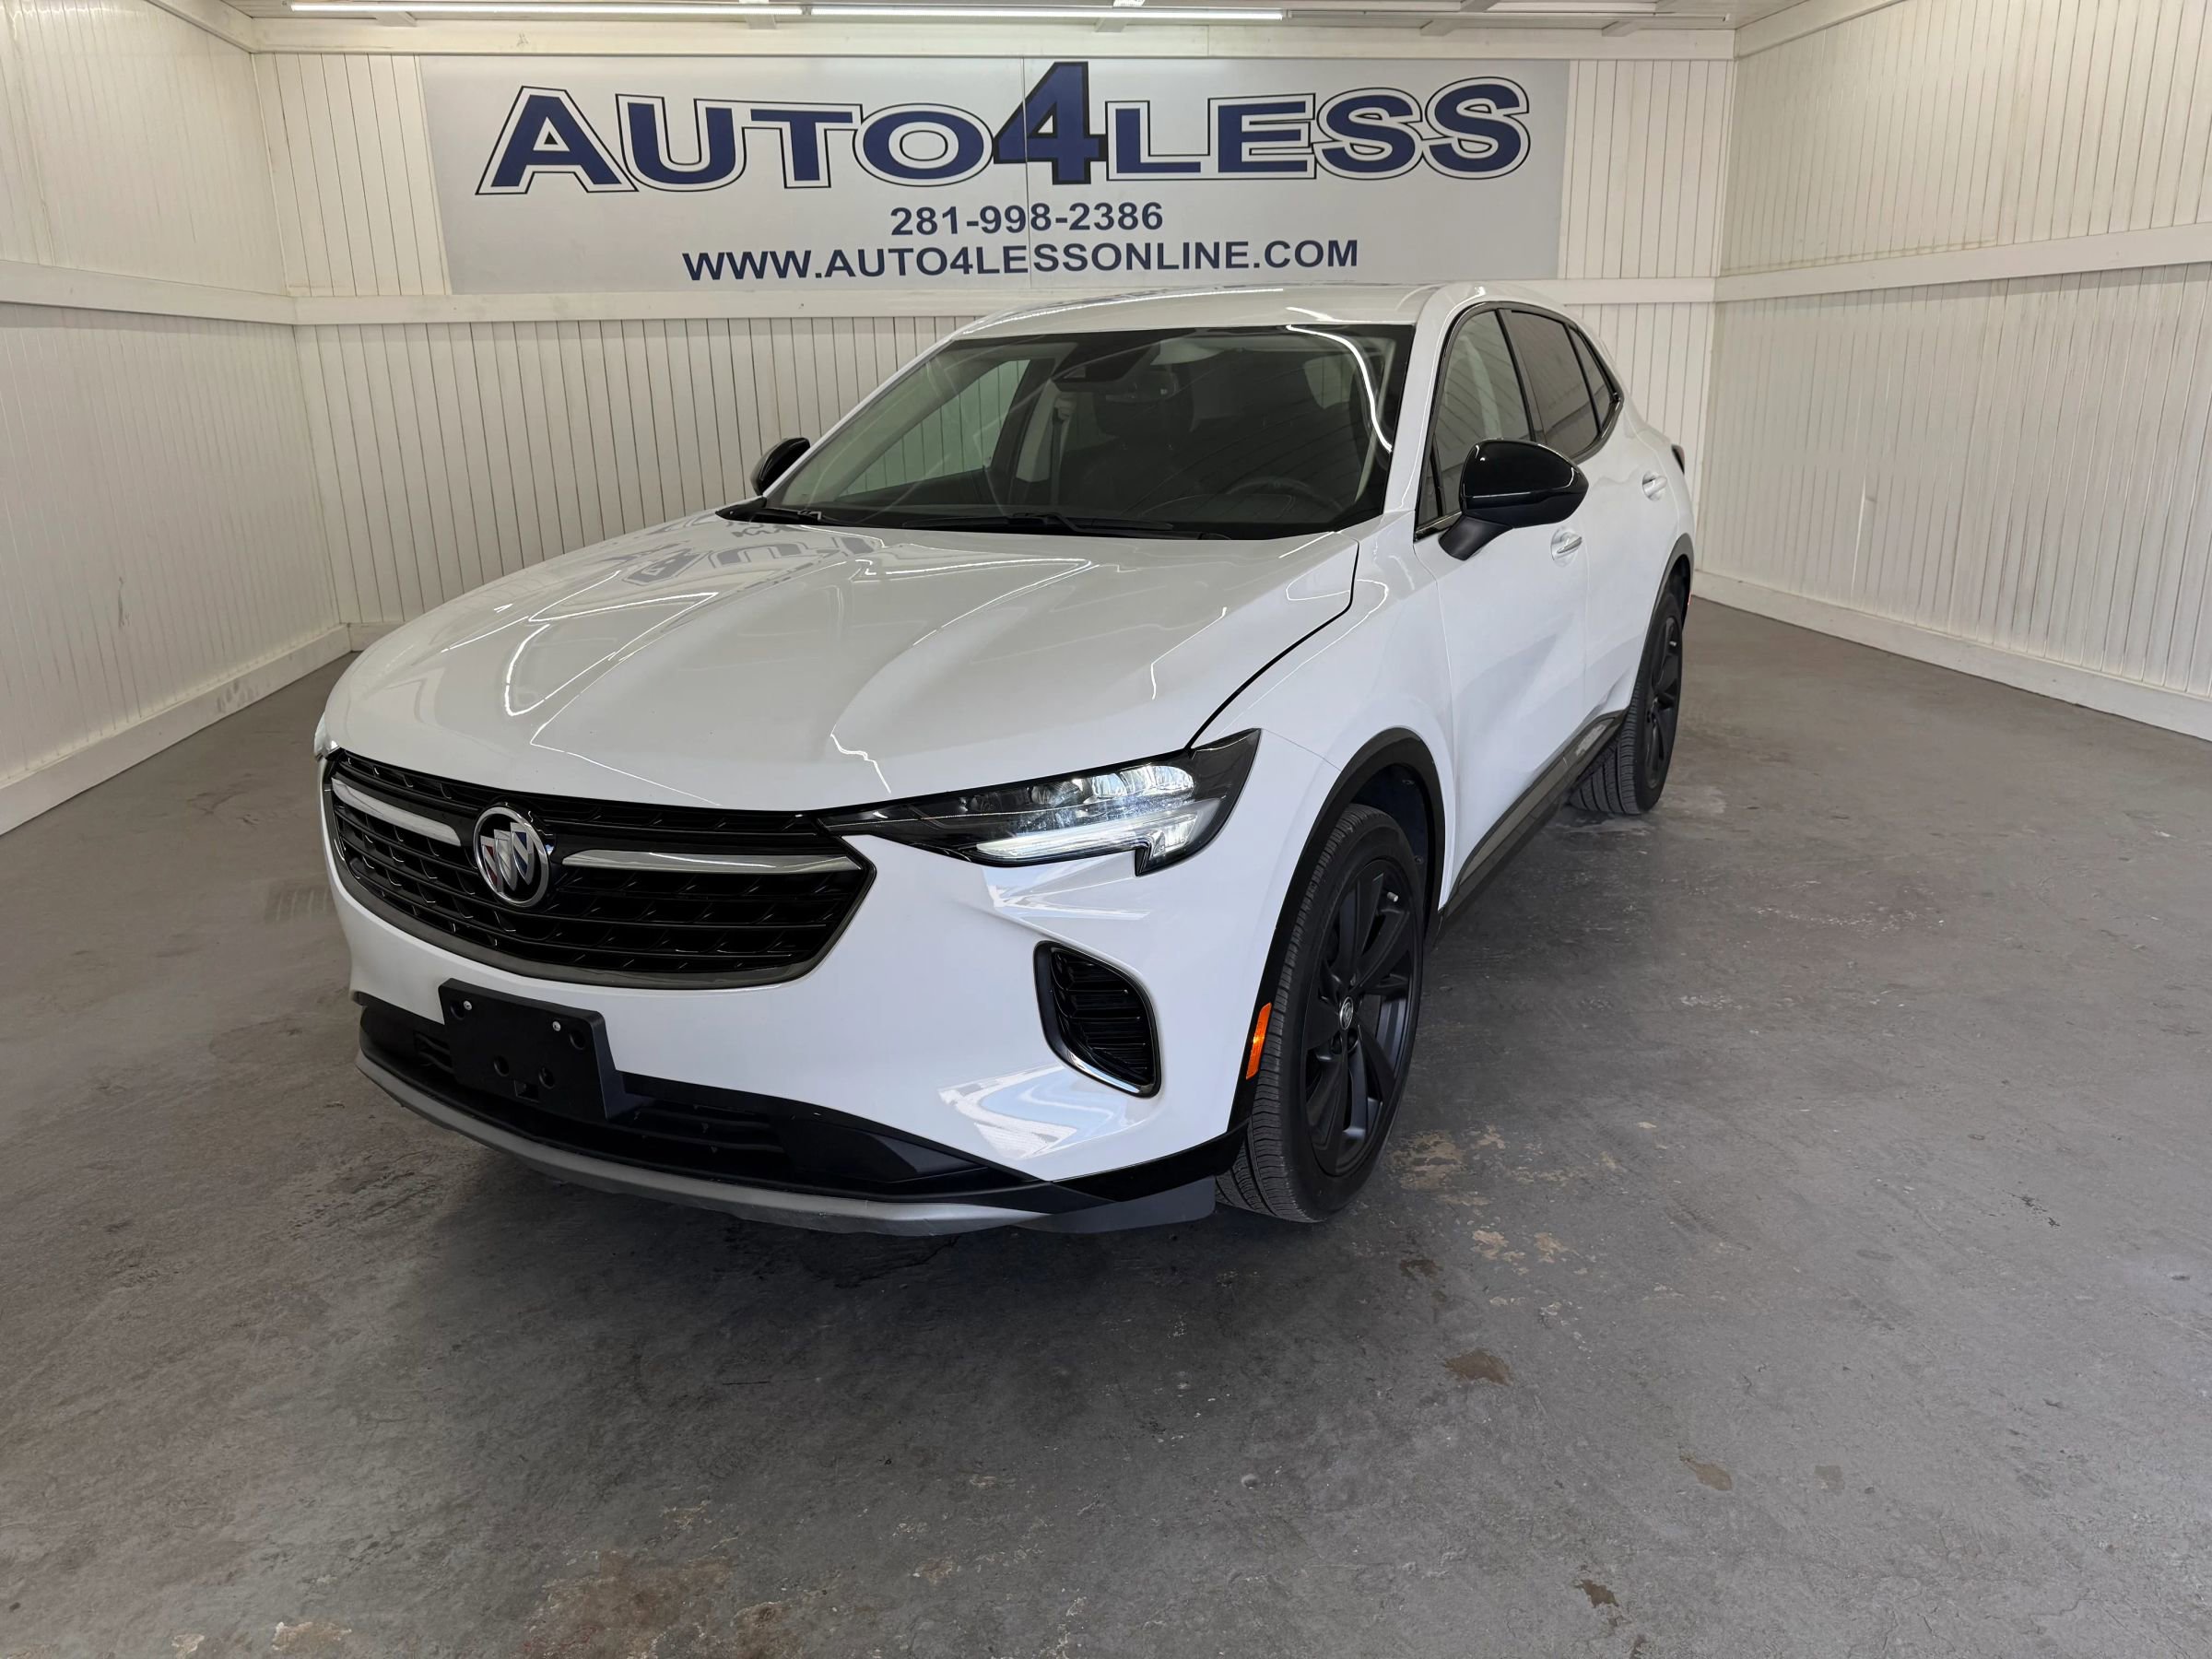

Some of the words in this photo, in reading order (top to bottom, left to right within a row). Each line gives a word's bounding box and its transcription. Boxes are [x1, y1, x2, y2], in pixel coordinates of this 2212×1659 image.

[476, 61, 1531, 195] AUTO4LESS
[890, 202, 1164, 236] 281-998-2386
[682, 240, 1359, 280] WWW.AUTO4LESSONLINE.COM
